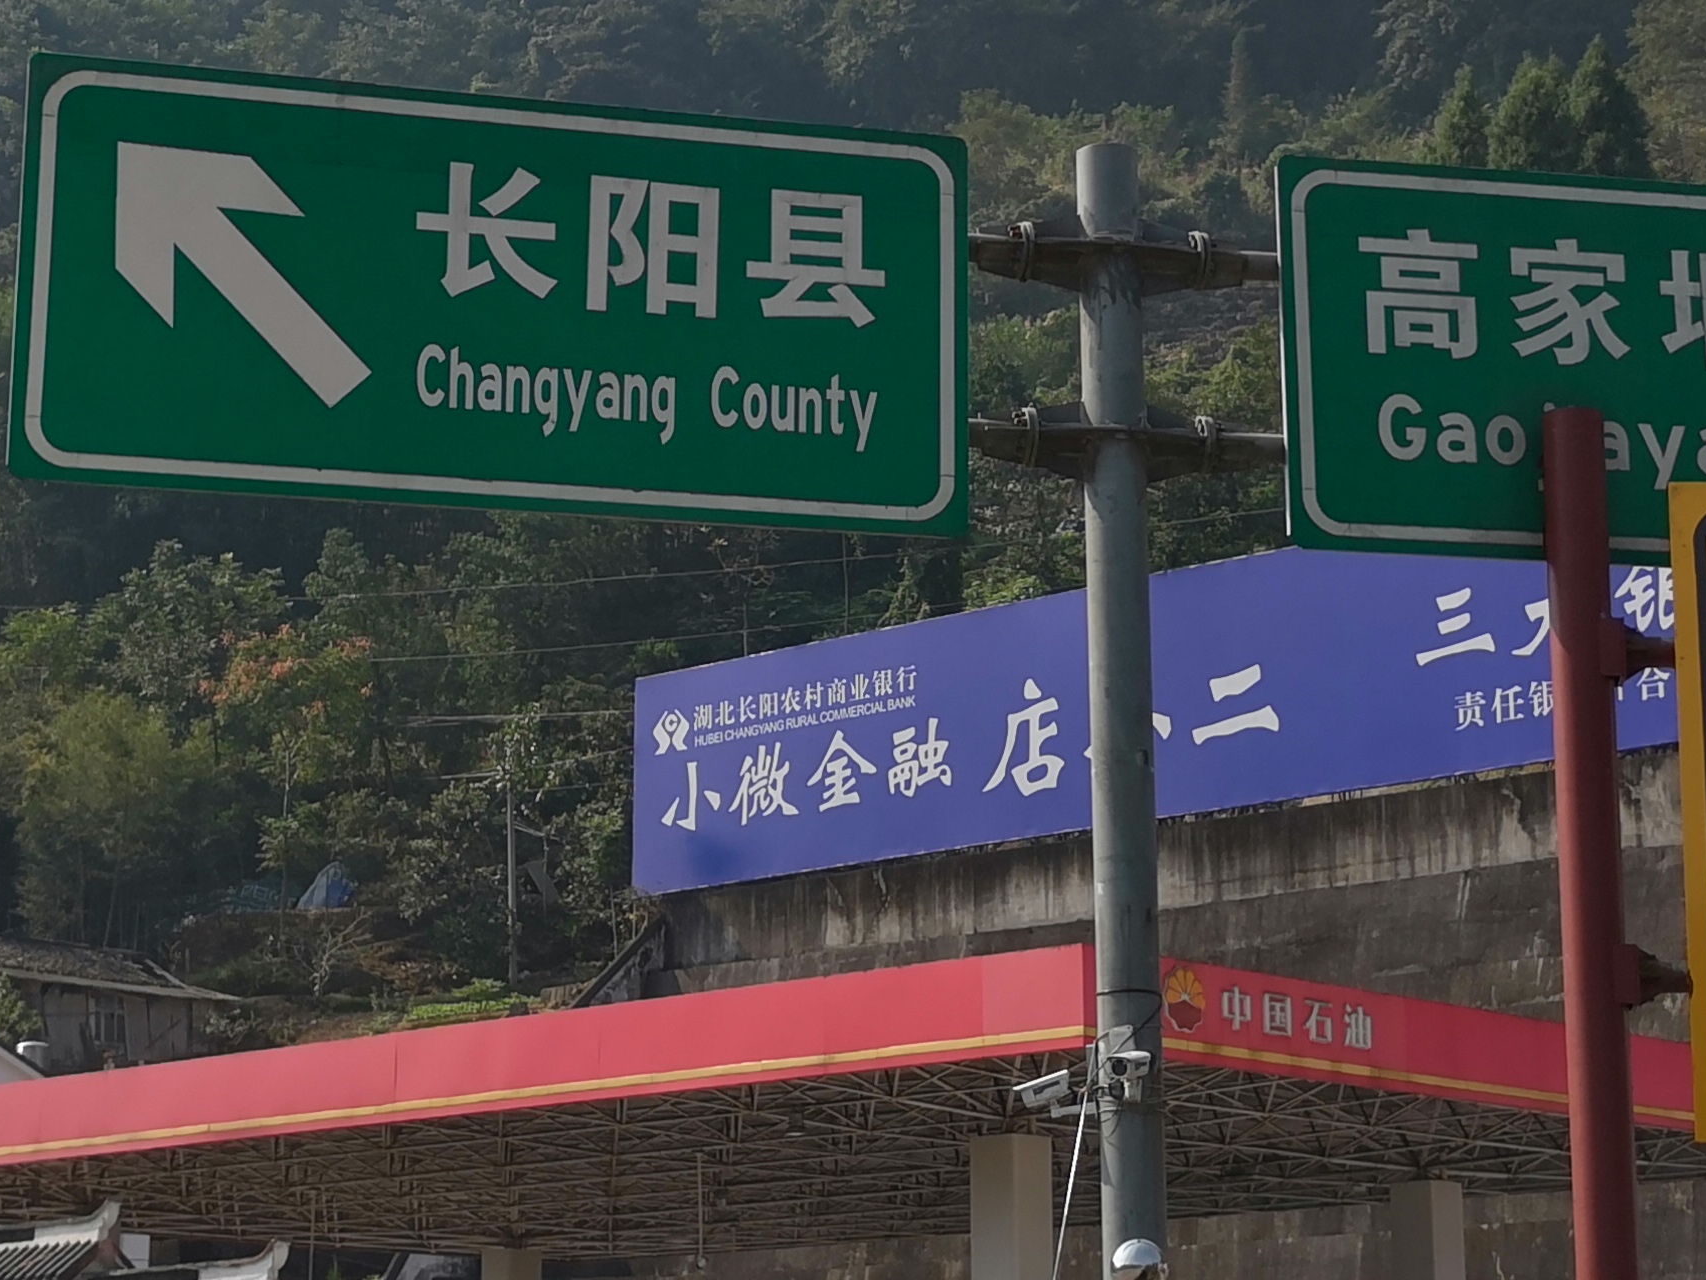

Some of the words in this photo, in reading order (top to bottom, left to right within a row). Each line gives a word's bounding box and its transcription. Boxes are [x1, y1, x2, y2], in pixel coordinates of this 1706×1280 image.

[416, 161, 887, 328] 长阳县
[415, 343, 677, 445] Changyang
[710, 365, 879, 452] County
[693, 664, 918, 731] 湖北长阳农村商业银行
[694, 731, 724, 748] HUBEI
[724, 720, 785, 741] CHANGYANG
[785, 713, 819, 729] RURAL
[819, 701, 886, 723] COMMERCIAL
[886, 695, 916, 710] BANK
[661, 717, 953, 831] 小微金融
[981, 663, 1280, 797] 店二
[1221, 985, 1373, 1050] 中国石油
